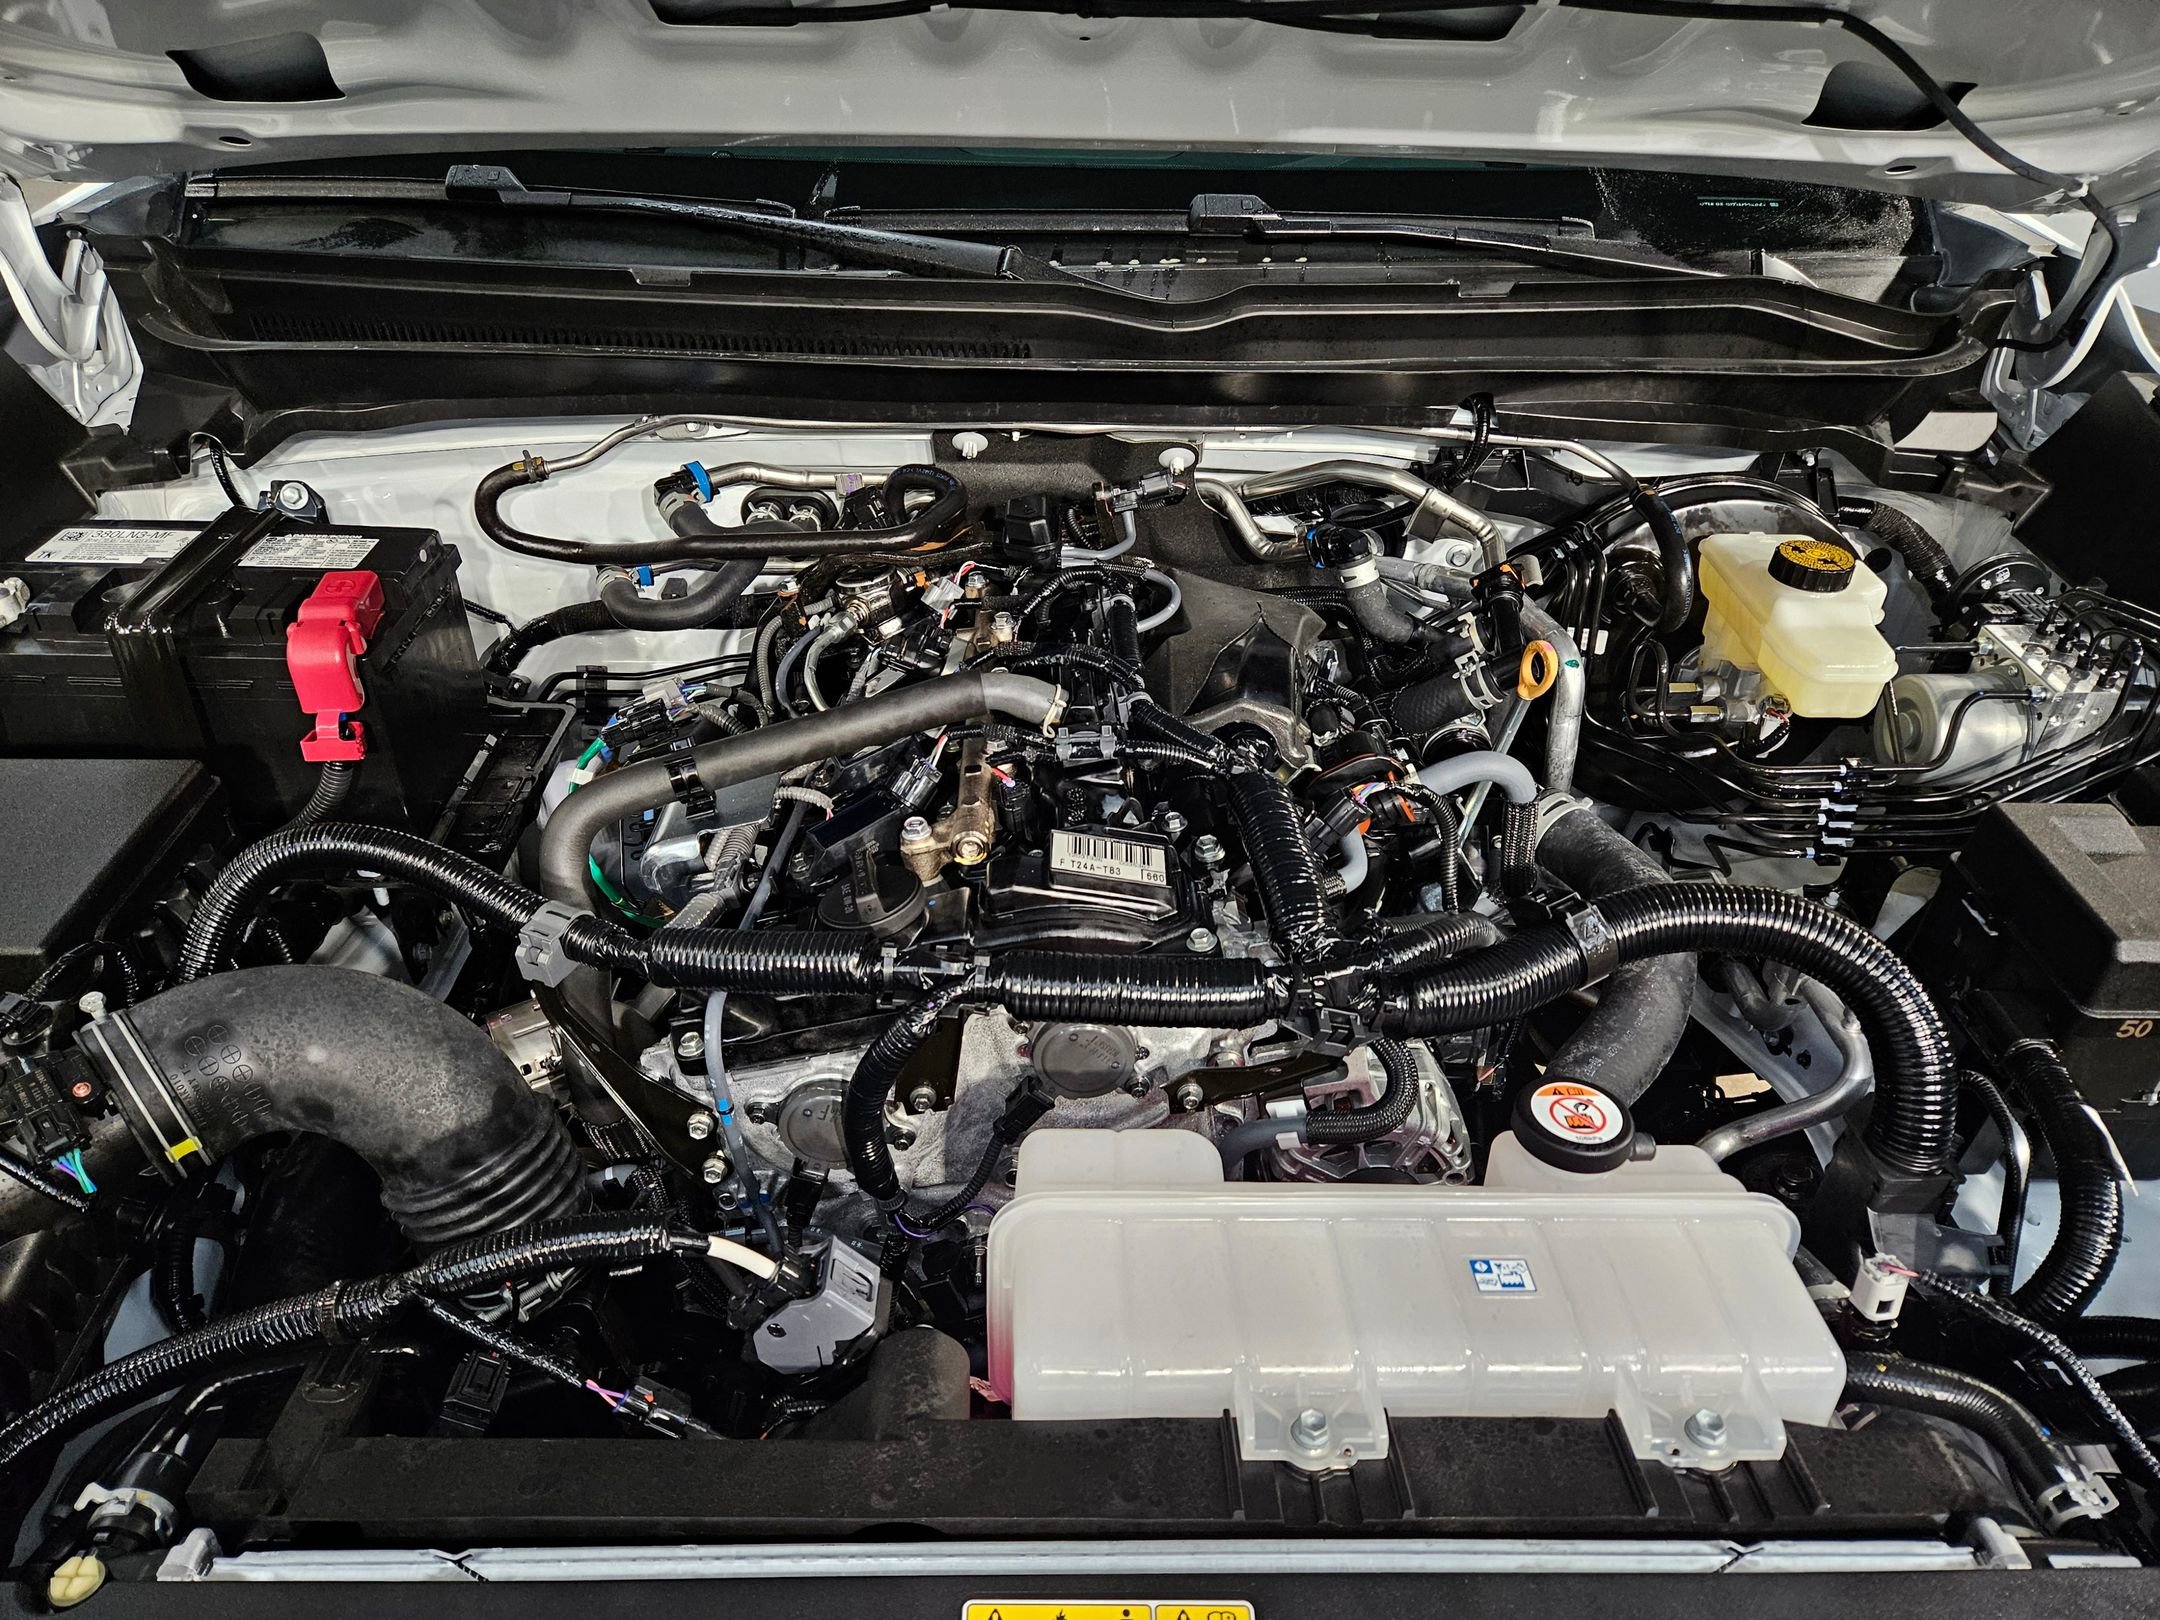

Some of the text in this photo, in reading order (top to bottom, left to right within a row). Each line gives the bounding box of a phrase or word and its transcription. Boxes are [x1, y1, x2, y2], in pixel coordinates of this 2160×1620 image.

[91, 530, 176, 539] 380LN3-MF
[1060, 858, 1065, 866] F
[2116, 1020, 2153, 1038] 50
